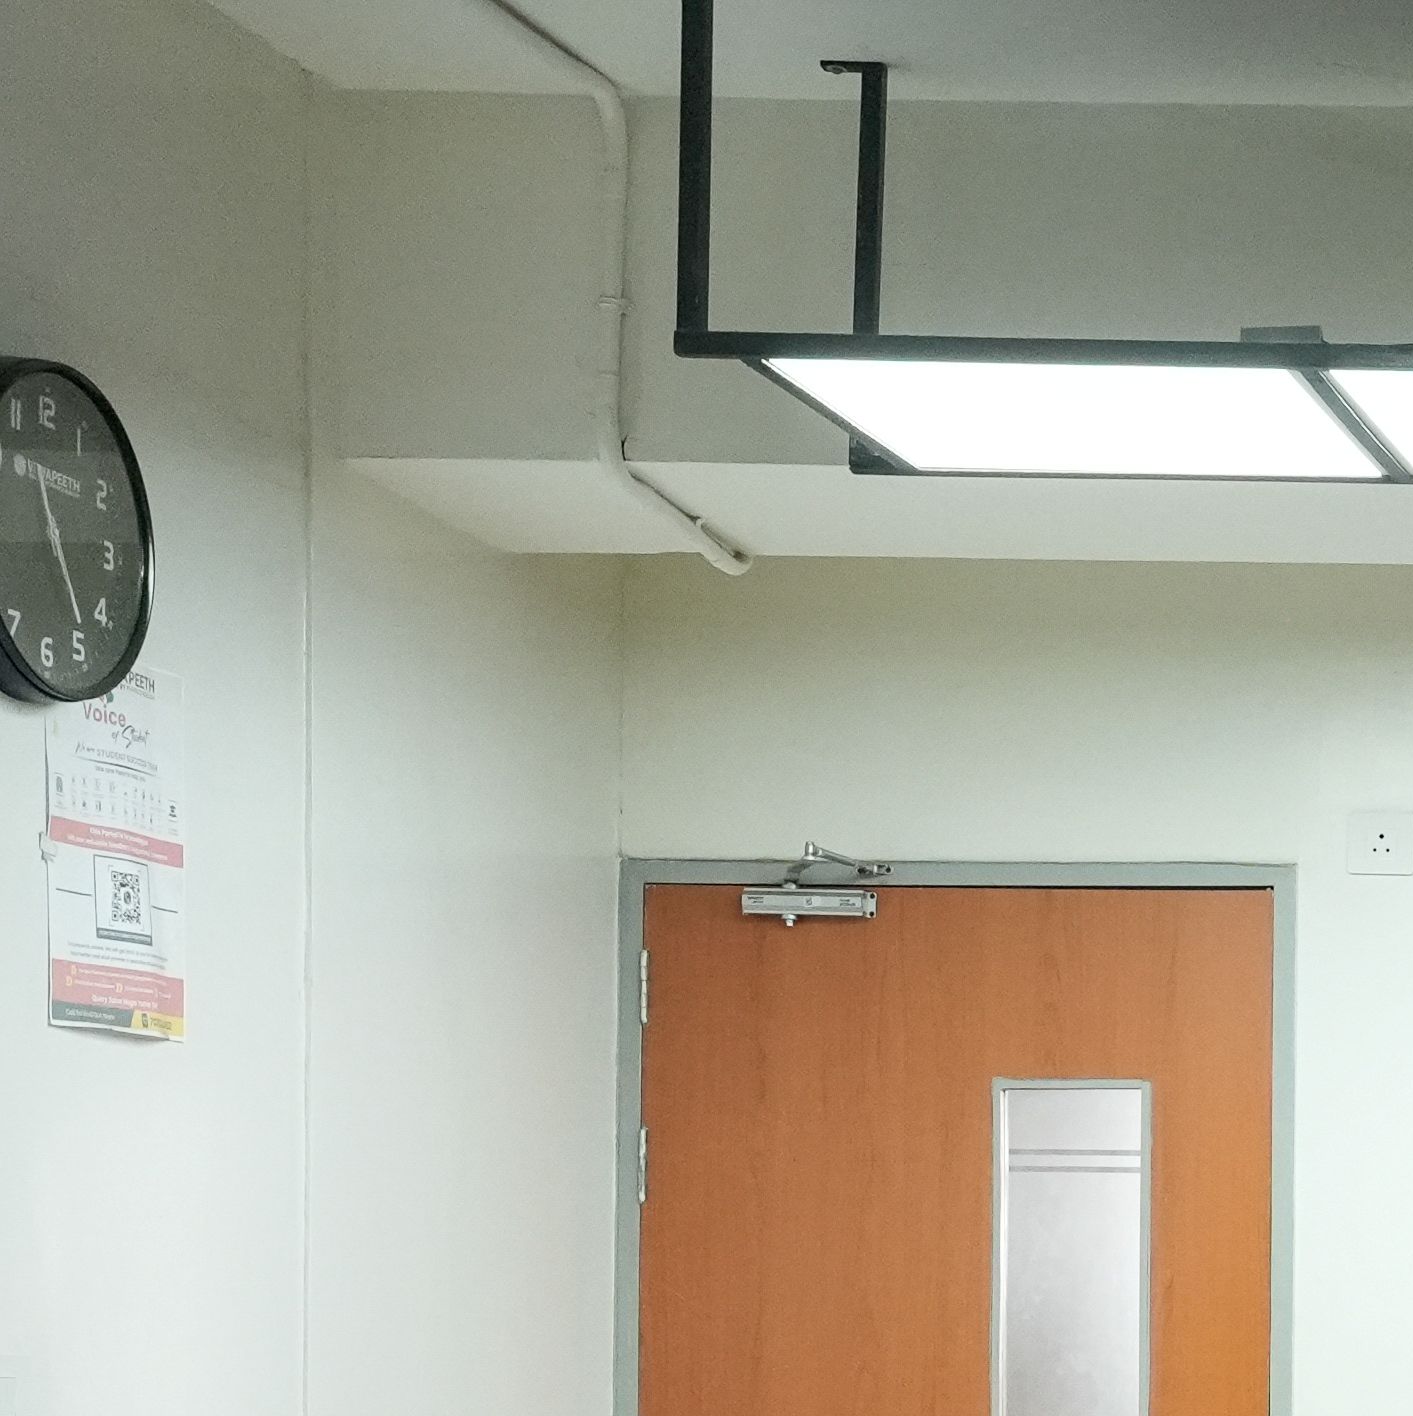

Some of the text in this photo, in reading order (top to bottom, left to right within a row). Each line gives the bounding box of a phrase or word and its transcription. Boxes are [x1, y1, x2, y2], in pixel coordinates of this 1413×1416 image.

[10, 398, 21, 431] 11
[39, 395, 56, 430] 12
[96, 479, 107, 511] 2
[103, 539, 114, 571] 3
[7, 608, 21, 637] 7
[94, 597, 107, 627] 4
[41, 636, 54, 667] 6
[72, 629, 86, 661] 5
[83, 702, 126, 727] Voice
